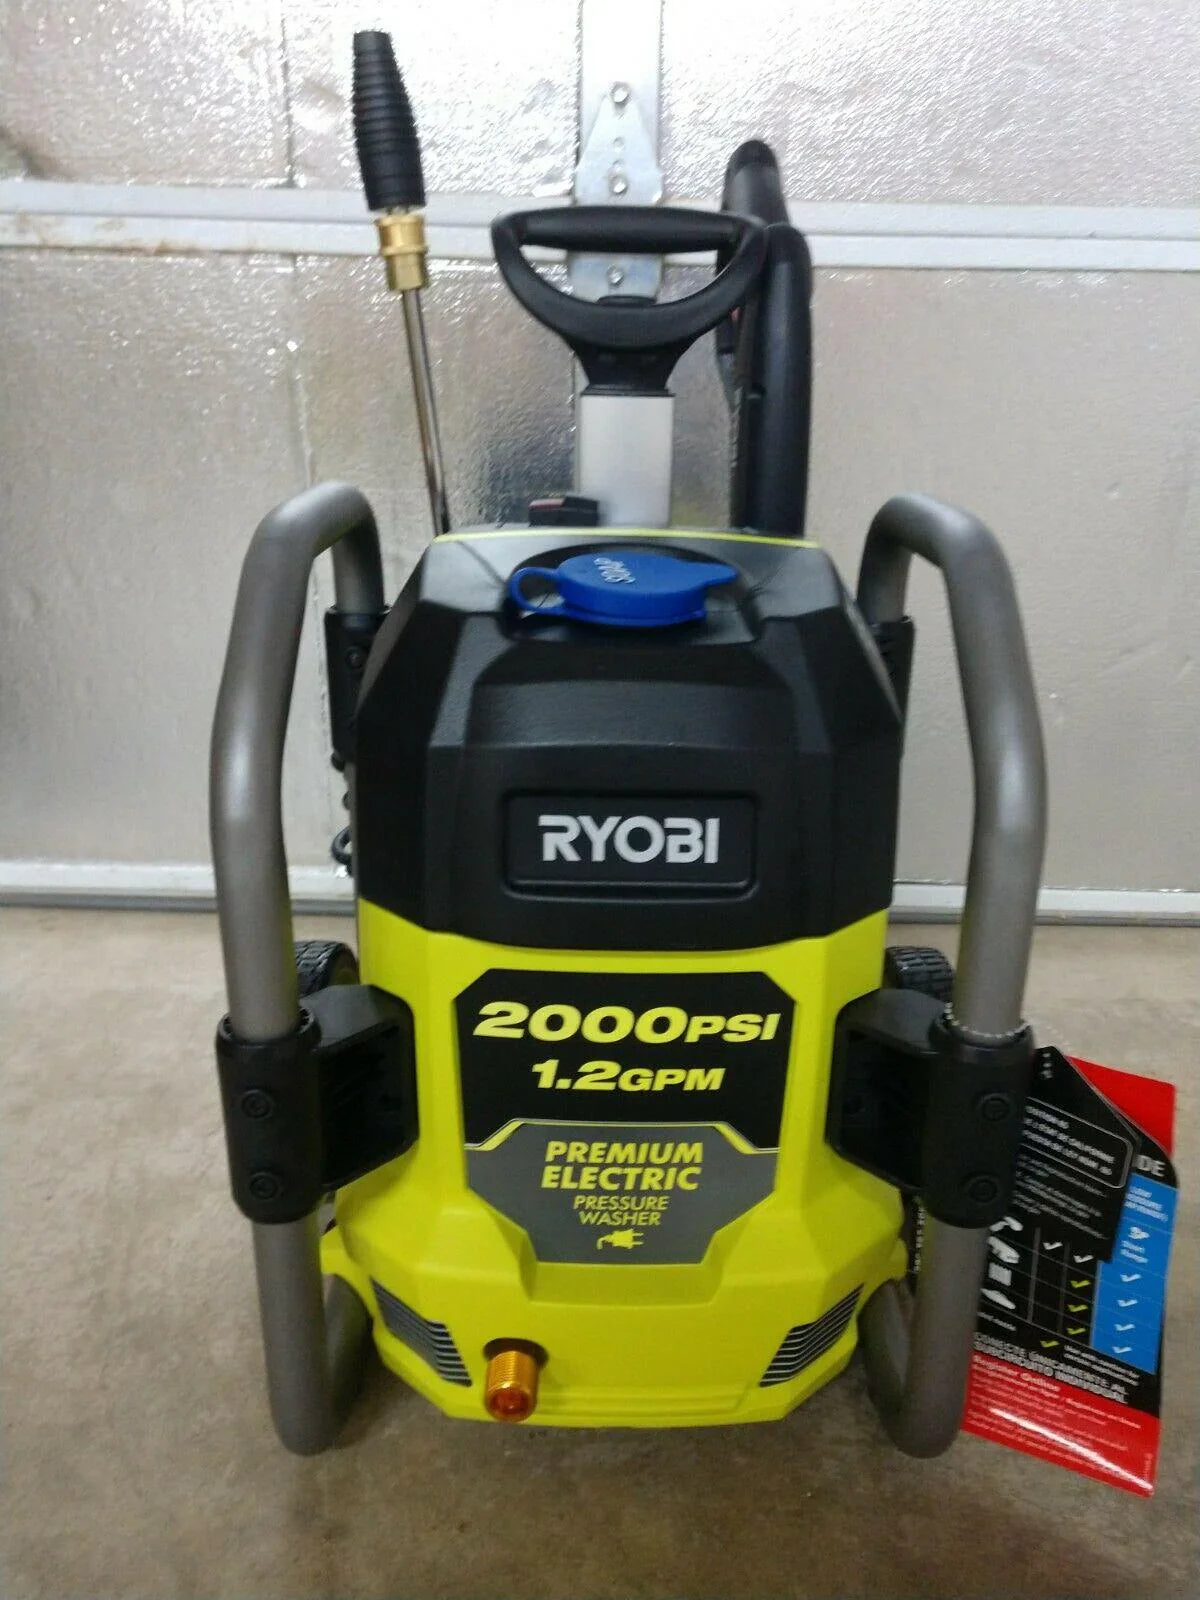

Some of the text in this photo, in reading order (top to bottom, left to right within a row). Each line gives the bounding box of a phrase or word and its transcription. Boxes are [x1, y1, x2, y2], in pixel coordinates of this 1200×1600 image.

[538, 814, 720, 864] RYOBI
[472, 1001, 782, 1043] 2000PSI
[531, 1059, 726, 1092] 1.2GPM
[545, 1141, 703, 1164] PREMIUM
[540, 1166, 700, 1191] ELECTRIC
[572, 1194, 669, 1212] PRESSURE
[578, 1210, 661, 1227] WASHER
